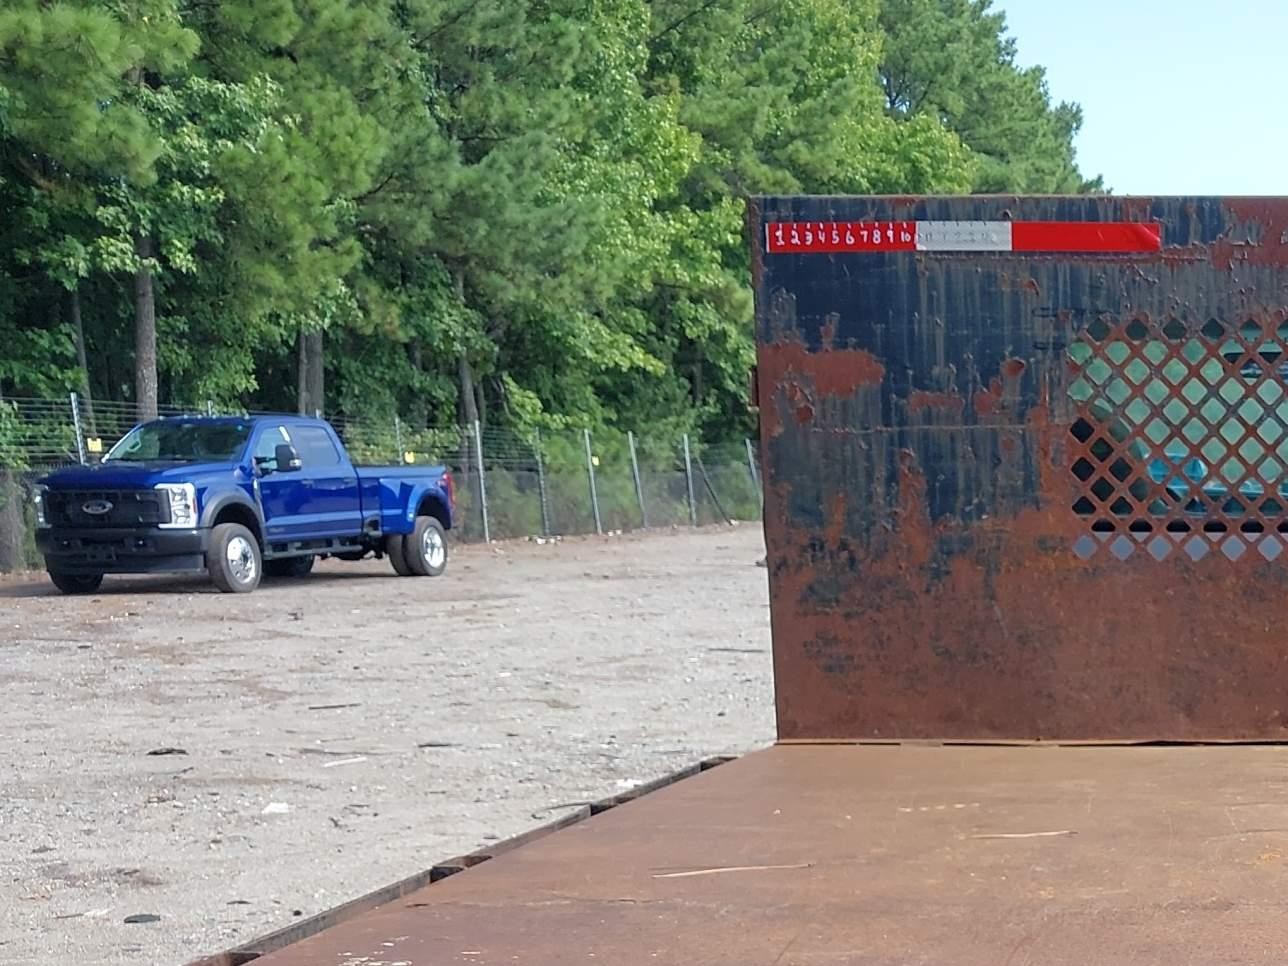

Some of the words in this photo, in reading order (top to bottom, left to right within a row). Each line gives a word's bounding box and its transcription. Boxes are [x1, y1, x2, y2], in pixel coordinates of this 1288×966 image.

[775, 230, 785, 246] 1
[791, 230, 801, 245] 2
[805, 231, 813, 246] 3
[818, 230, 826, 244] 4
[831, 230, 840, 244] 5
[845, 230, 855, 245] 6
[860, 230, 868, 243] 7
[872, 230, 881, 245] 8
[886, 230, 894, 244] 9
[900, 231, 911, 243] 10
